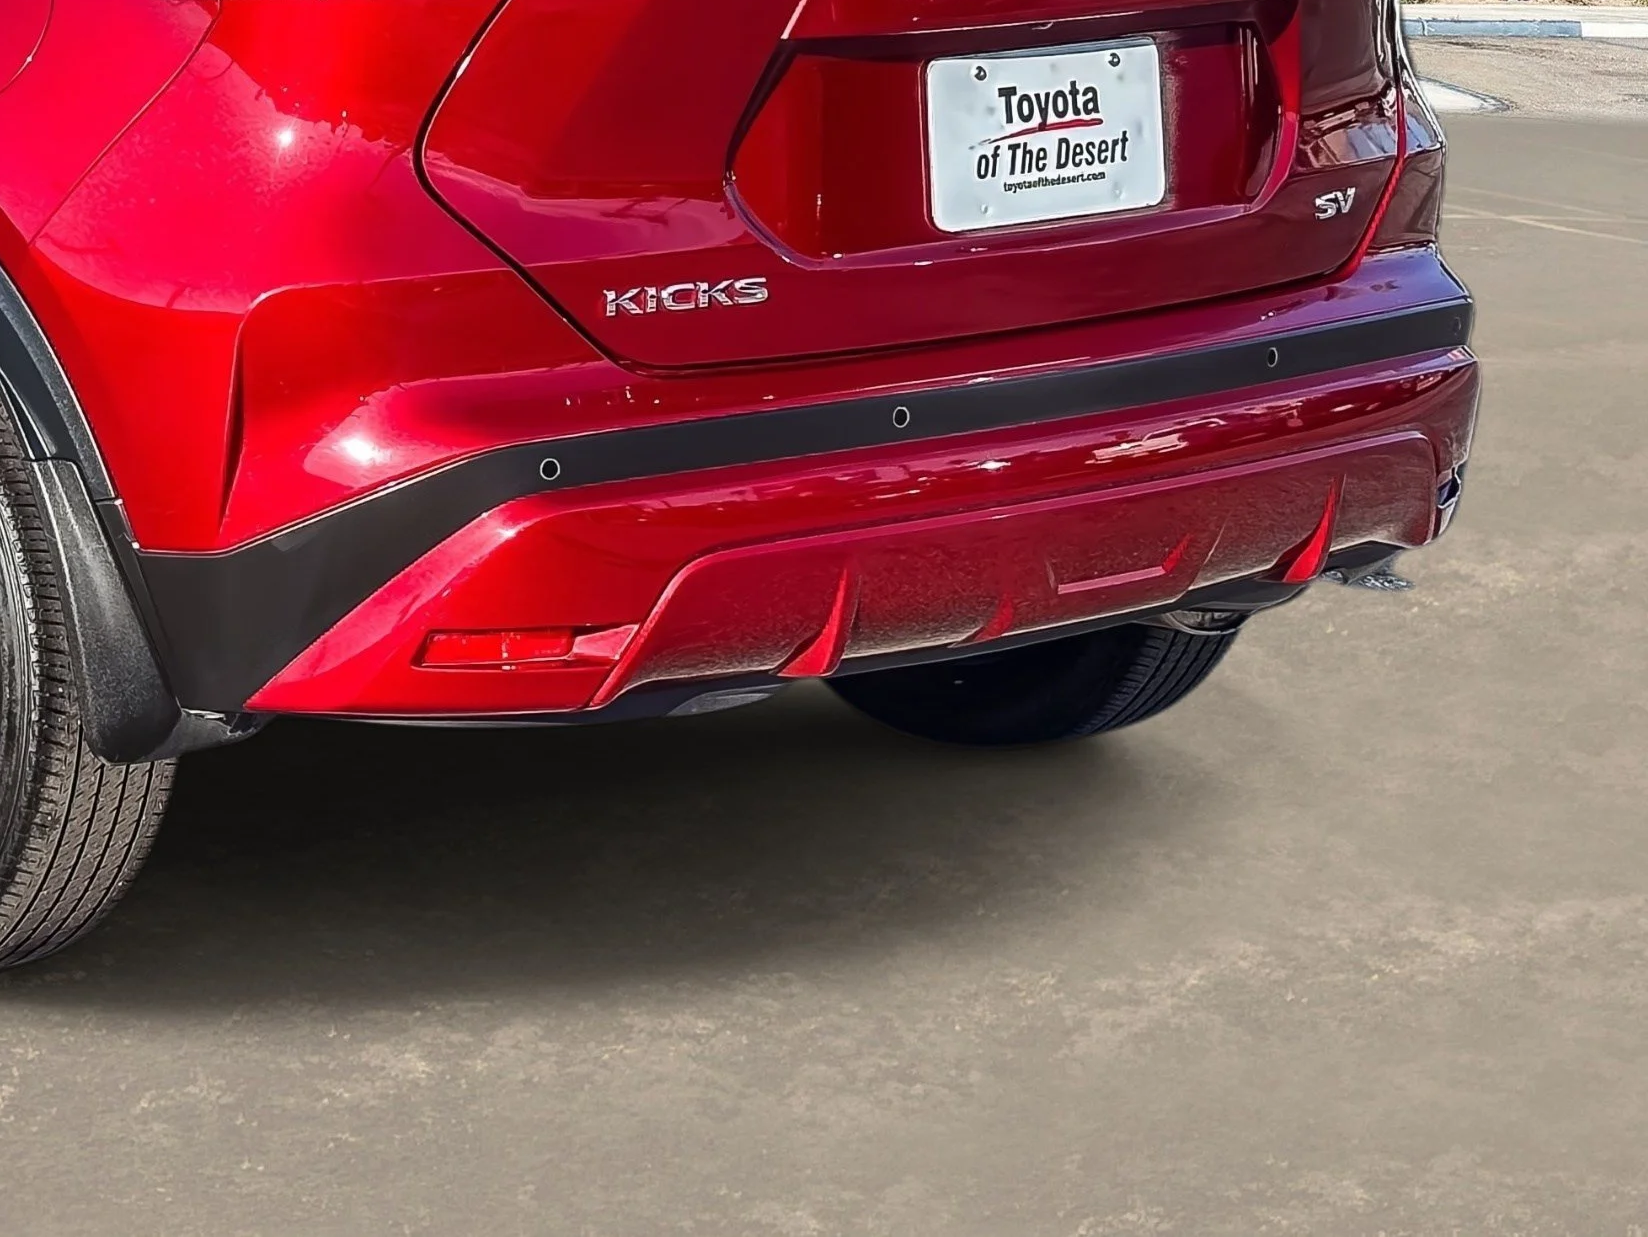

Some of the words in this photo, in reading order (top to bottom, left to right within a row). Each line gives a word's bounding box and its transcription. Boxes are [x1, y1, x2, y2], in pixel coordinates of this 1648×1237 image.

[998, 80, 1101, 131] Toyota
[977, 145, 1001, 180] of
[1008, 142, 1048, 176] The
[1055, 130, 1129, 170] Desert
[1003, 171, 1107, 194] toyotaofthedesert.com
[1315, 187, 1356, 220] SV
[603, 277, 769, 317] KICKS
